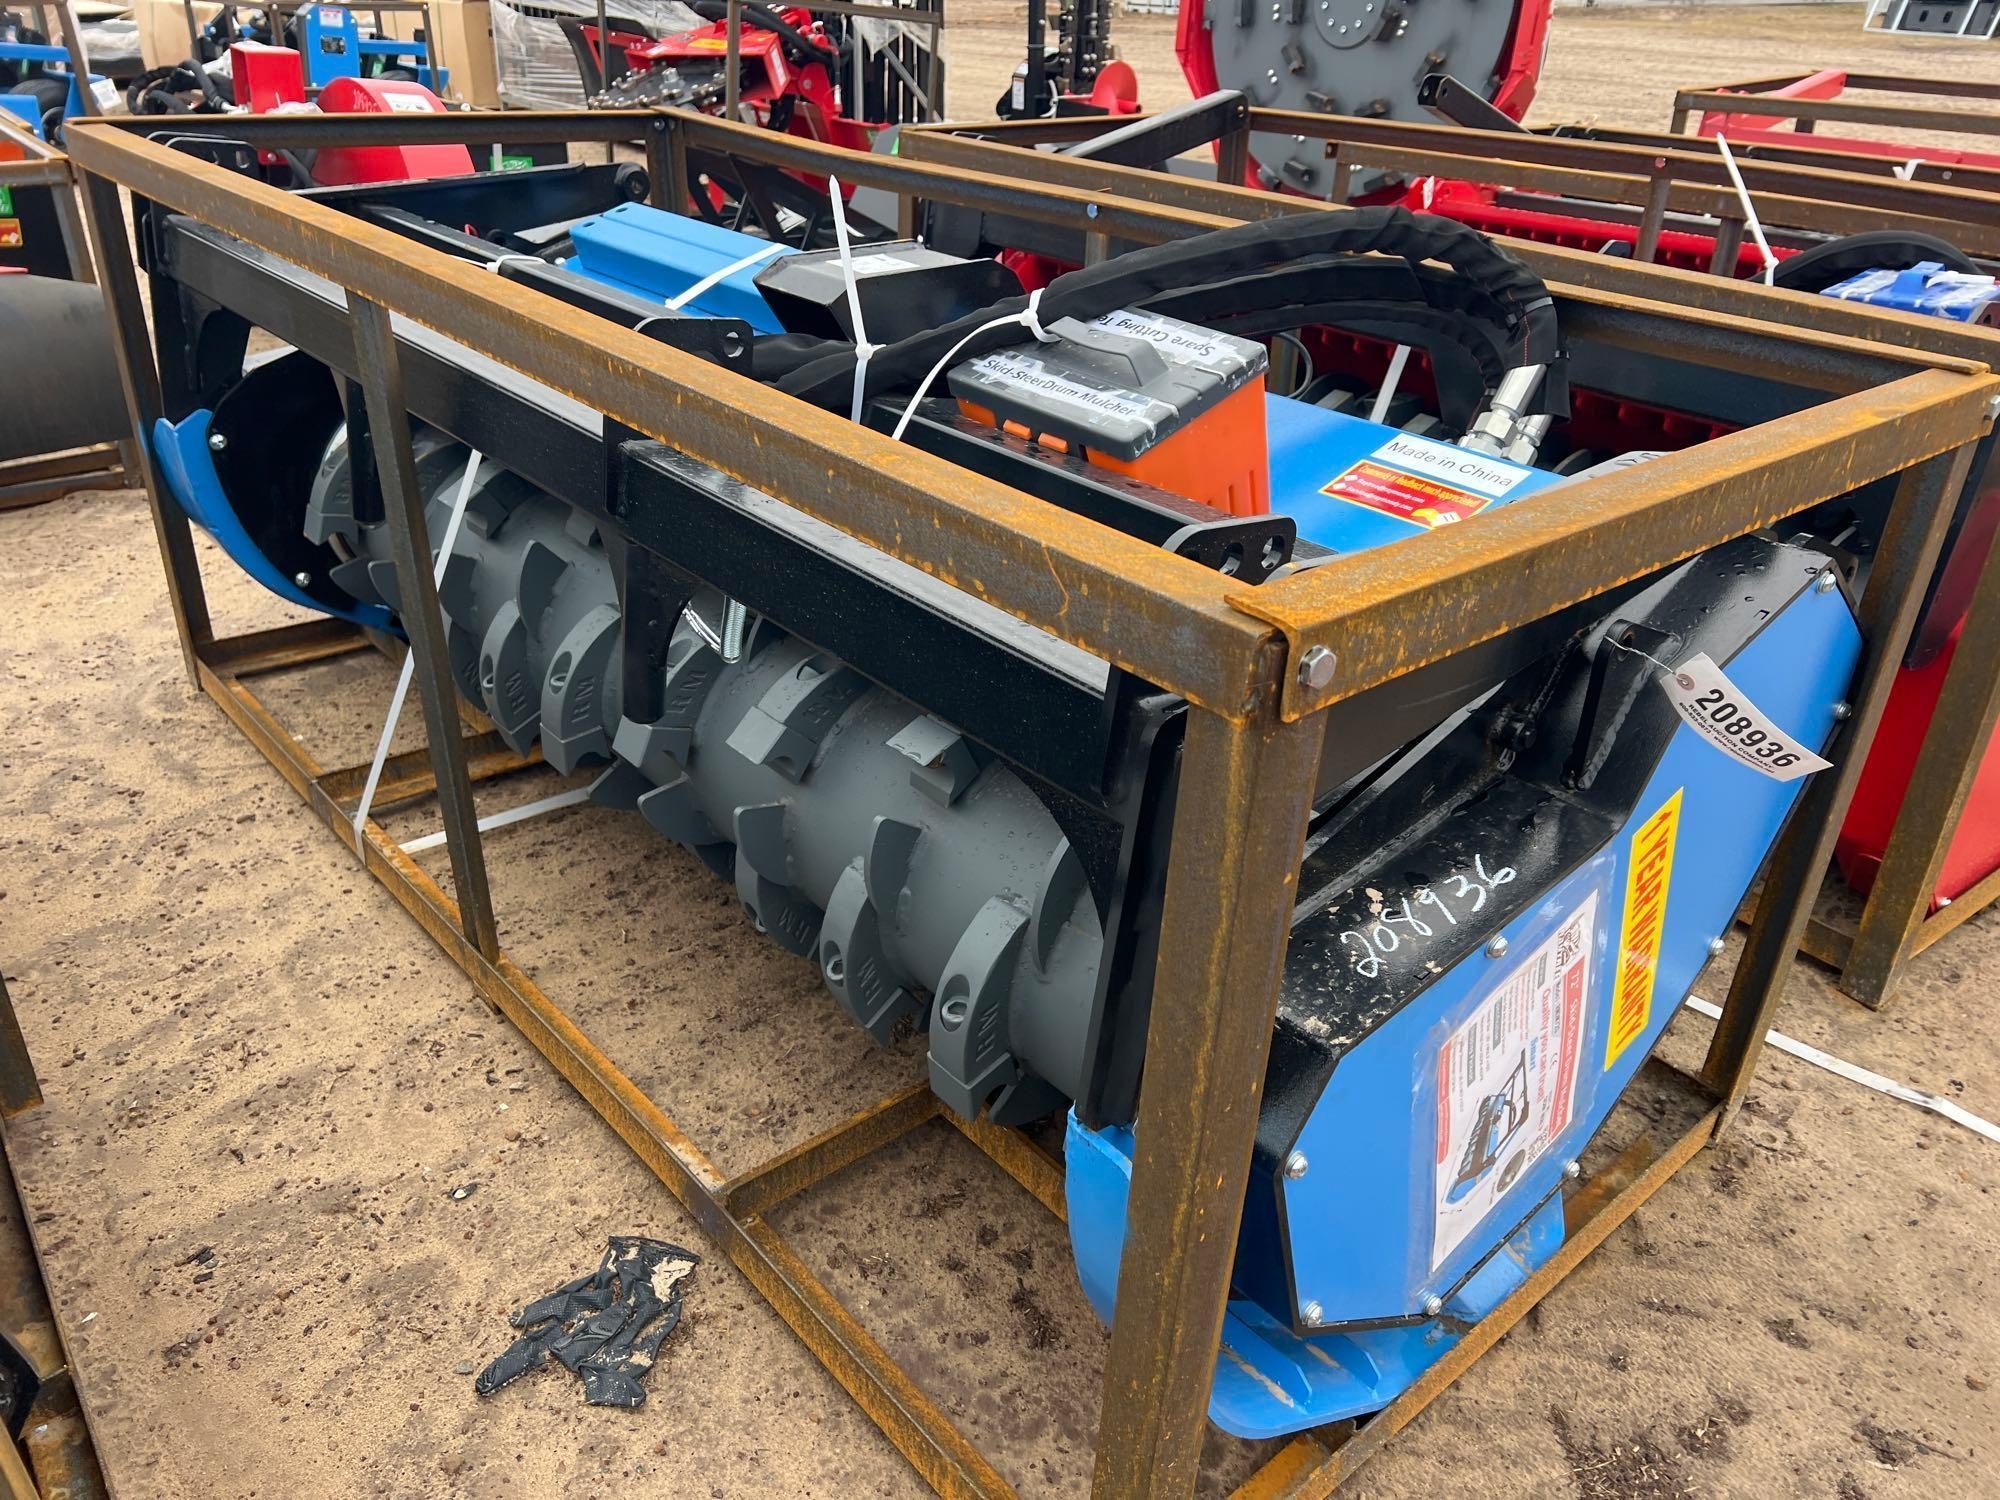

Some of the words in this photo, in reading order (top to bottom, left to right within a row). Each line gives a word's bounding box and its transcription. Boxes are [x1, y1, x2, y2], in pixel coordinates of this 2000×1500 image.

[1115, 319, 1169, 342] Cutting
[1171, 336, 1215, 357] Spare
[1078, 392, 1138, 416] Mulcher
[1387, 441, 1436, 463] Made
[1438, 456, 1456, 469] in
[1460, 463, 1513, 486] China
[1688, 704, 1708, 726] REBEL
[1708, 724, 1738, 748] AUCTION
[1738, 747, 1774, 769] COMPANY
[1695, 689, 1801, 768] 208936
[1641, 810, 1673, 844] 1
[1631, 826, 1670, 920] YEAR
[1340, 853, 1517, 978] 208936
[1616, 900, 1659, 1050] WARRANTY
